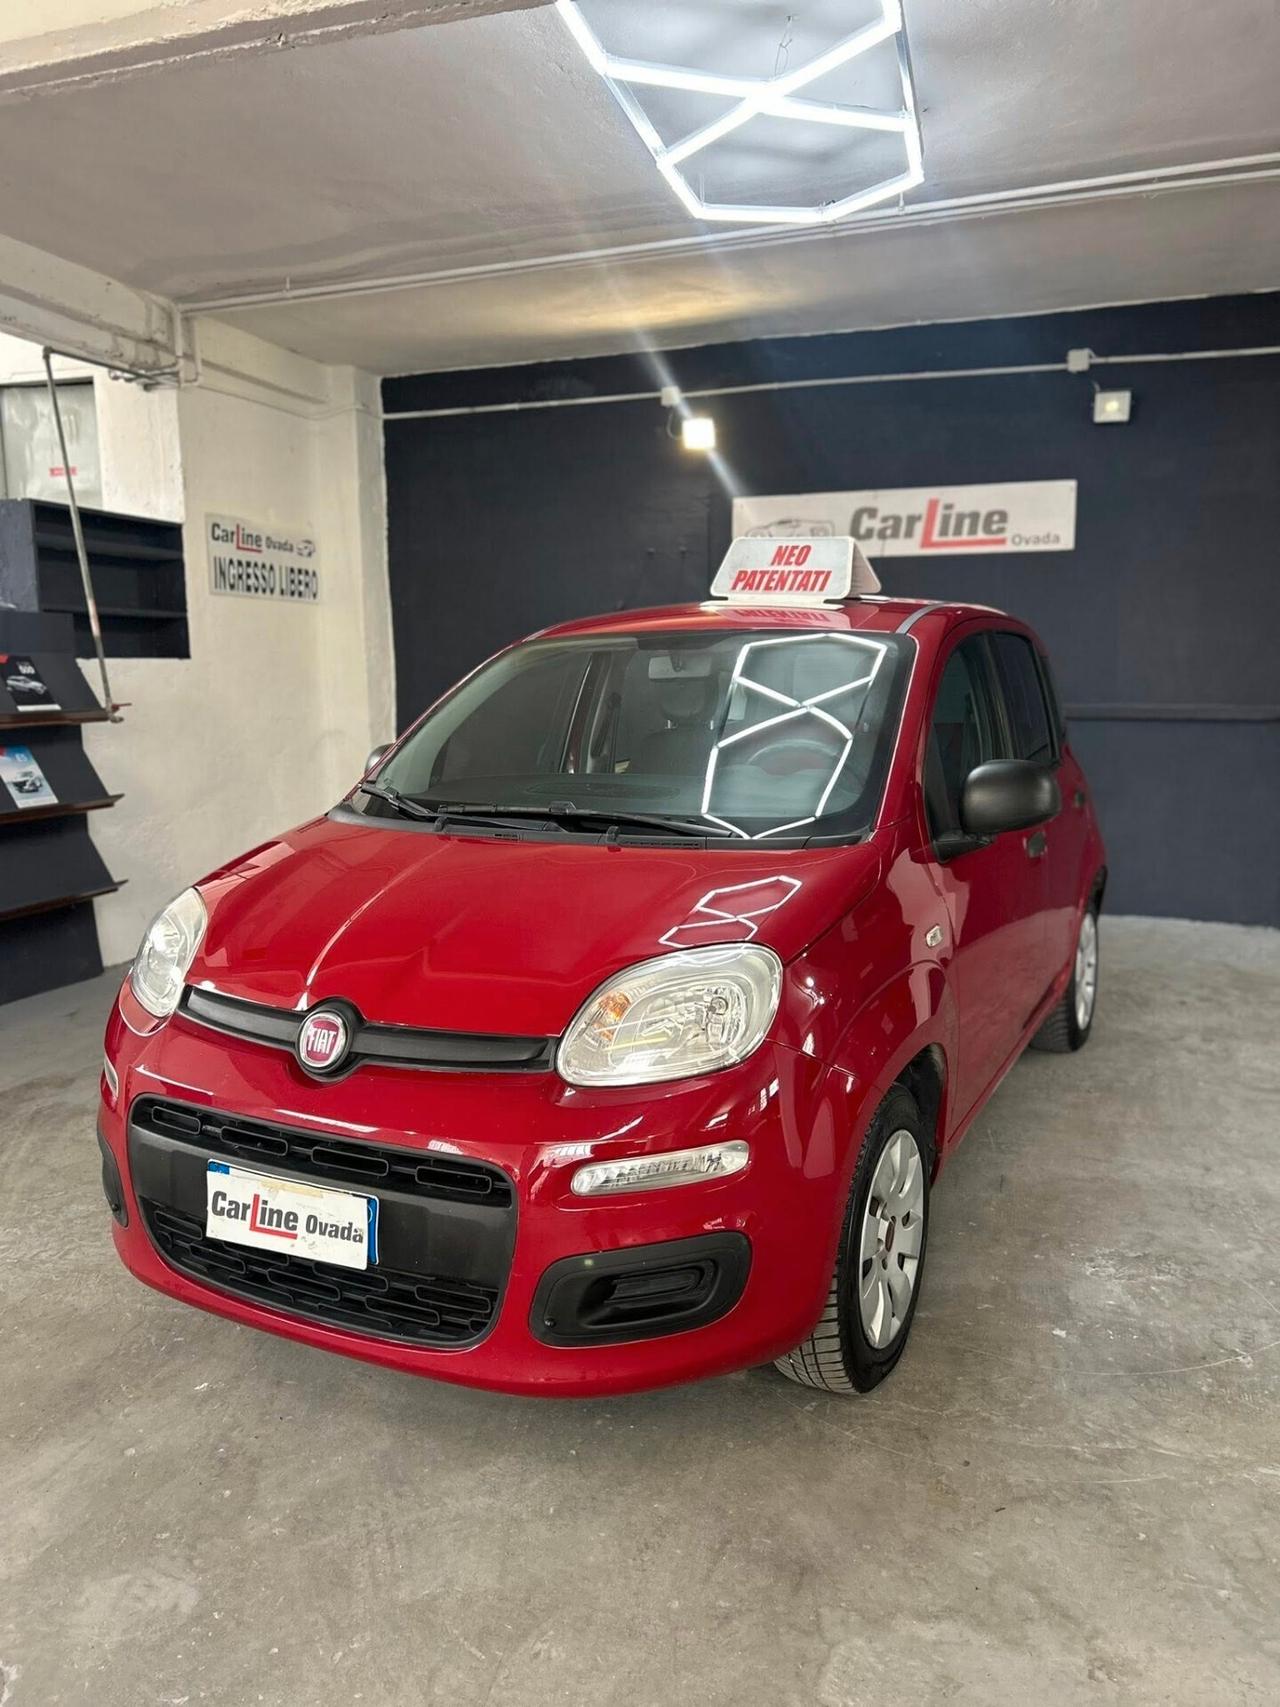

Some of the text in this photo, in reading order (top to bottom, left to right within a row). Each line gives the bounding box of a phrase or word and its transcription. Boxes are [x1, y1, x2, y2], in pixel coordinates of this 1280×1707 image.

[211, 522, 294, 553] CarLine Ovada
[850, 498, 1061, 549] CarLine Ovada
[770, 545, 812, 566] NEO
[213, 555, 319, 600] INGRESSO LIBERO
[730, 570, 832, 592] PATENTATI
[307, 1027, 338, 1055] FIAT
[211, 1190, 364, 1244] CarLine Ovada
